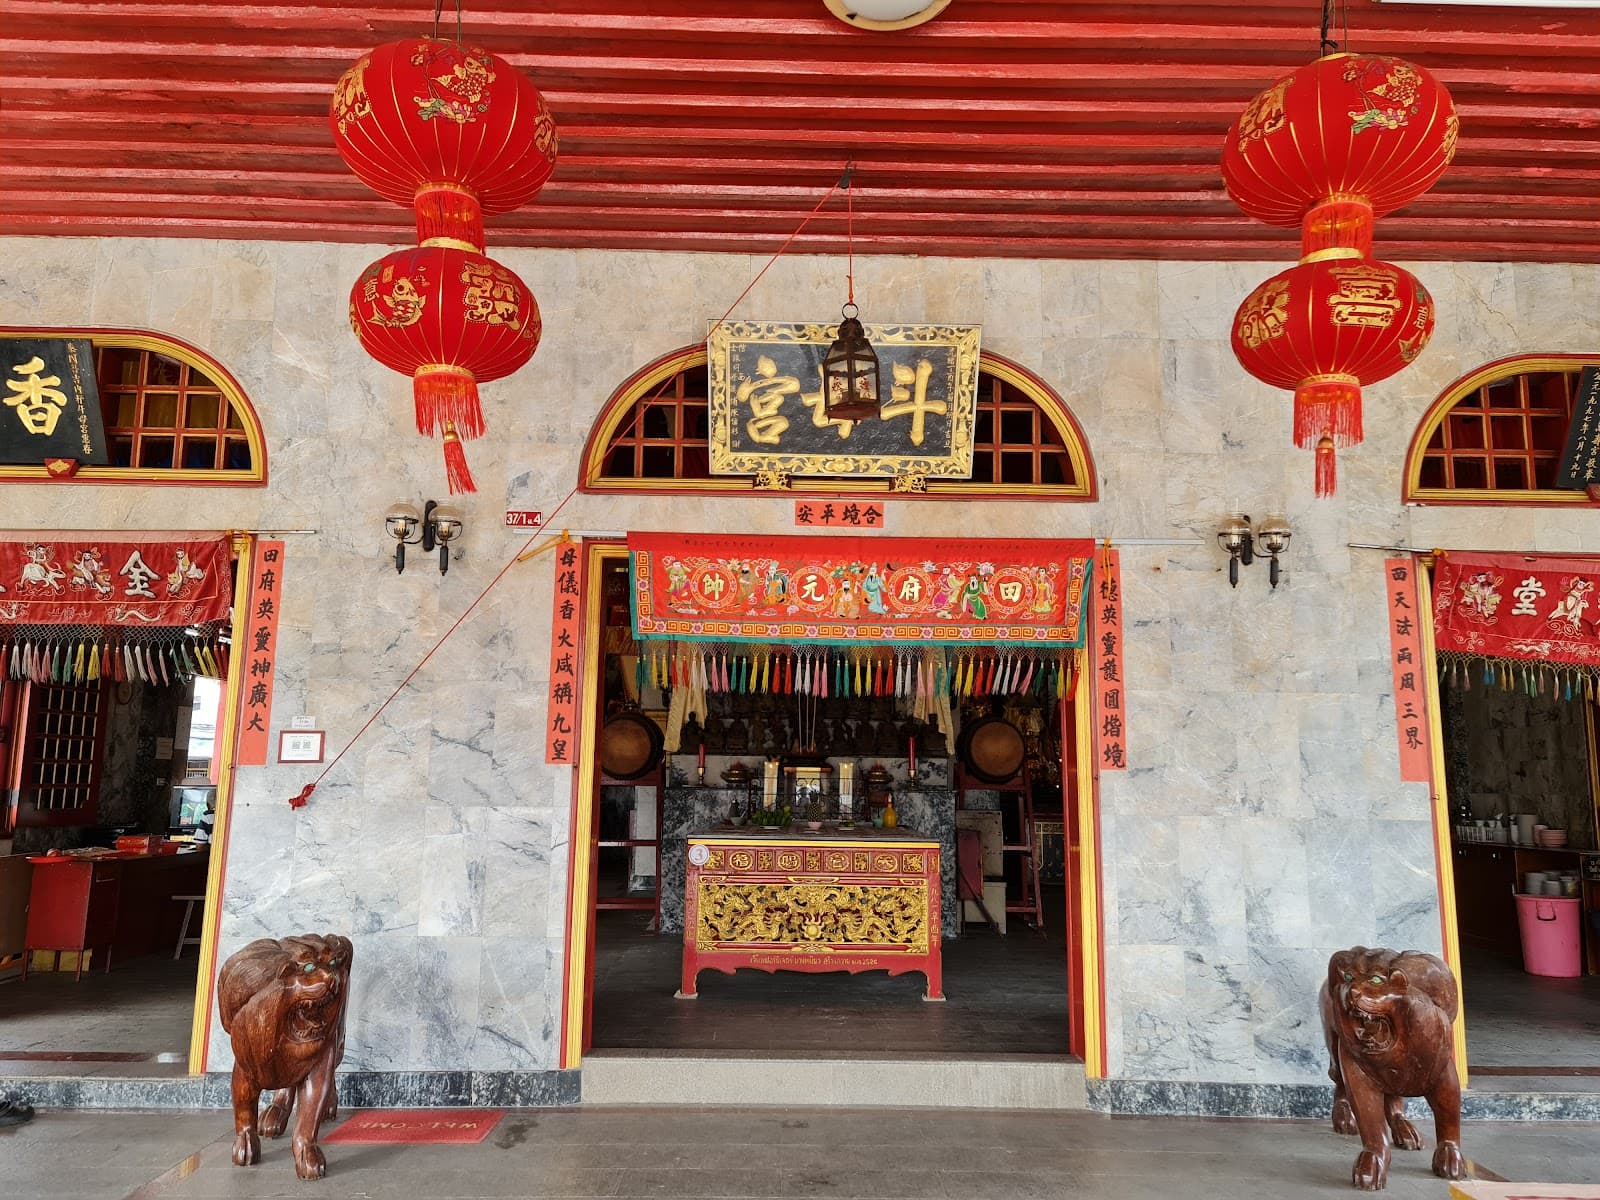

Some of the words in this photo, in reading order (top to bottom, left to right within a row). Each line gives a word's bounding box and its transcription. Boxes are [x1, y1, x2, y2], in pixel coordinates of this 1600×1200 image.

[4, 356, 68, 436] 香
[797, 504, 883, 524] 合境平安
